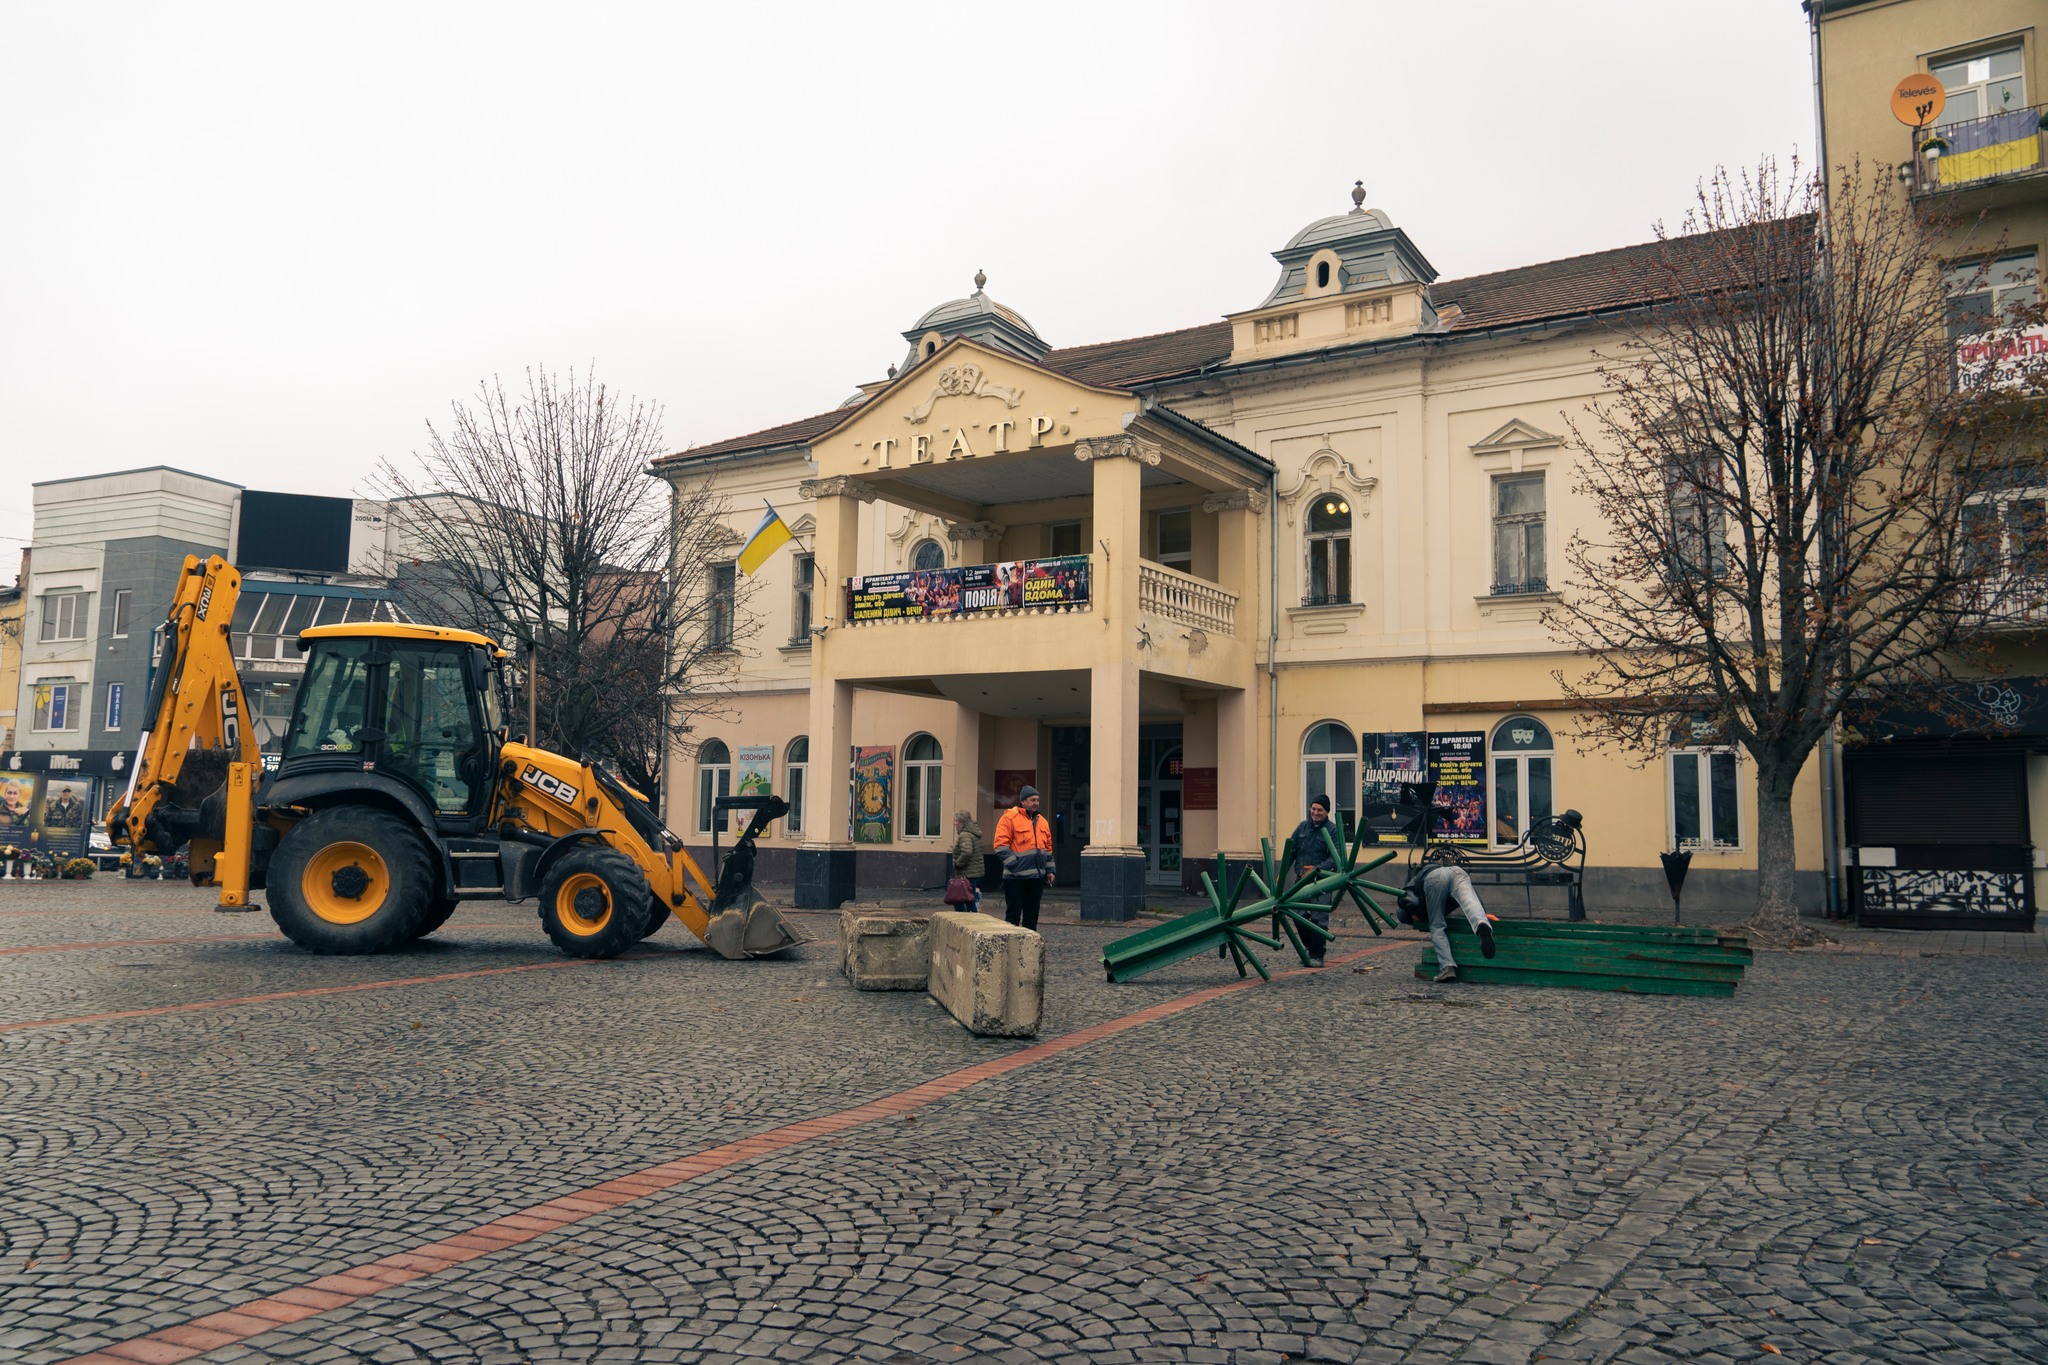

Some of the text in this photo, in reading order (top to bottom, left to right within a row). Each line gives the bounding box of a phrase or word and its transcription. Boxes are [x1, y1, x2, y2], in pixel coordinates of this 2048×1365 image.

[1898, 86, 1936, 98] Televés
[872, 416, 1054, 469] ТЕАТР
[1025, 578, 1056, 591] ОДИН
[855, 594, 862, 602] Не
[965, 588, 998, 608] ПОВІЯ
[1024, 588, 1063, 602] ВДОМА
[197, 586, 212, 618] 3CX
[854, 607, 882, 619] ШАЛЕНИЙ
[883, 607, 902, 618] ДІВИЧ
[906, 606, 922, 616] ВЕЧІР
[222, 692, 240, 750] JC
[1430, 737, 1439, 745] 21
[1441, 736, 1482, 744] ДРАМТЕАТР
[739, 753, 771, 761] КІЗОНЬКА
[1366, 768, 1423, 784] ШАХРАЙКИ
[522, 770, 577, 804] JCB
